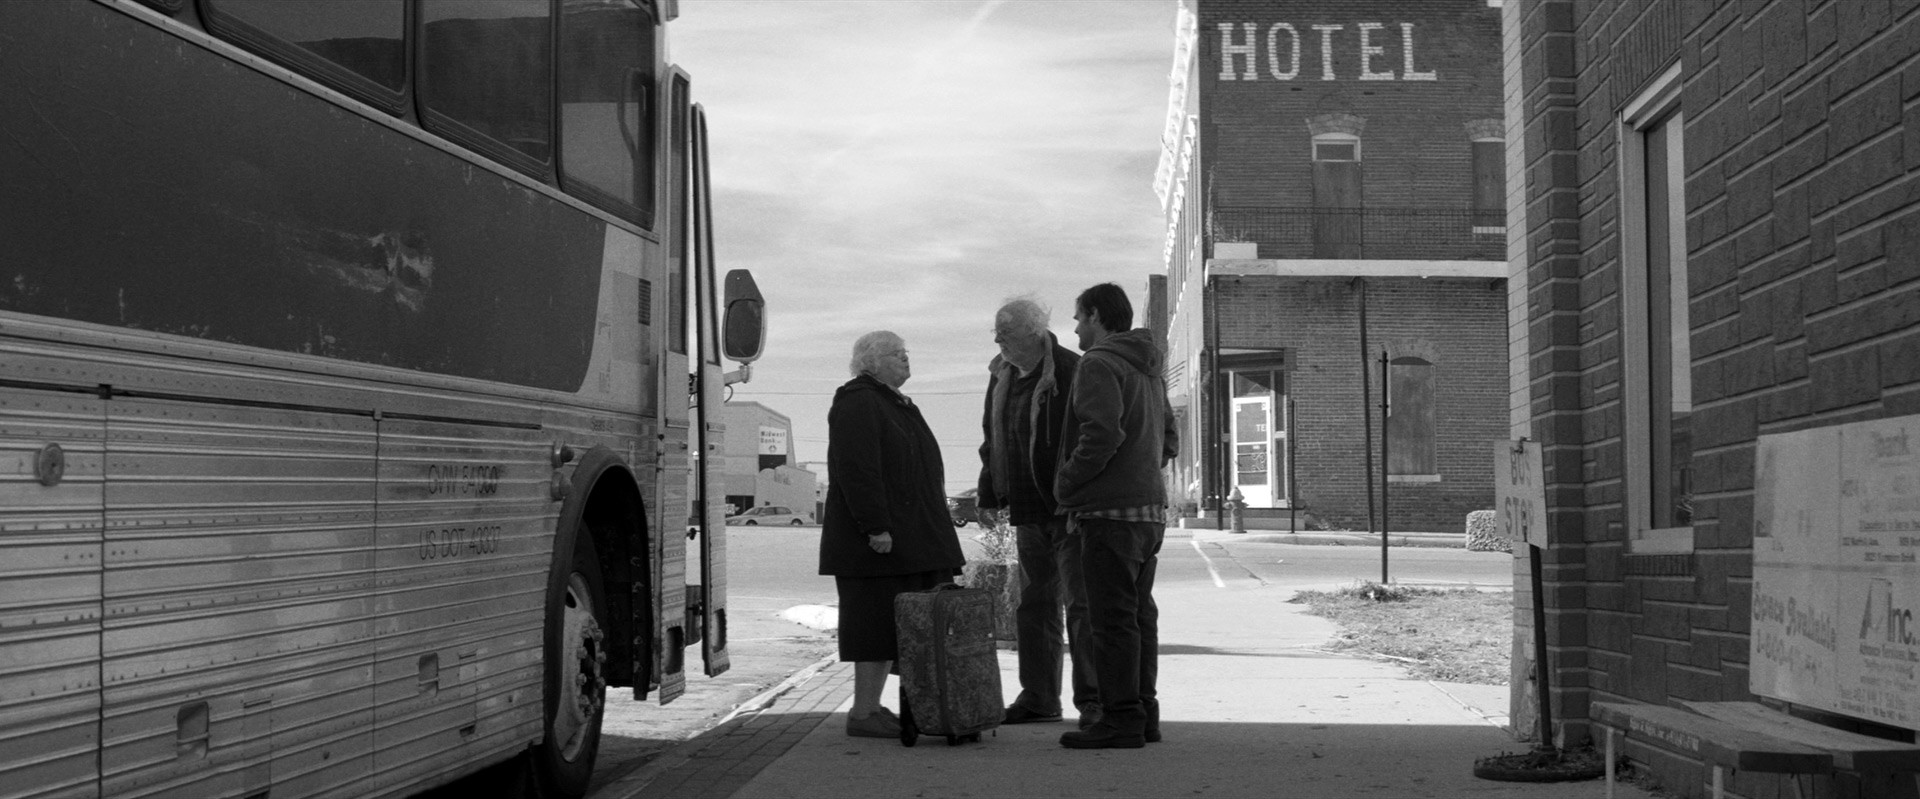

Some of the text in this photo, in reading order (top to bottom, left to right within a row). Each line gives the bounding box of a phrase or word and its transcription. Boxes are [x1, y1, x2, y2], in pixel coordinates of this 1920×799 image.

[1217, 22, 1437, 81] HOTEL
[428, 464, 458, 494] GVW
[1510, 446, 1532, 486] BUS
[1505, 496, 1534, 537] STOP
[420, 530, 436, 560] US
[441, 528, 466, 558] DOT
